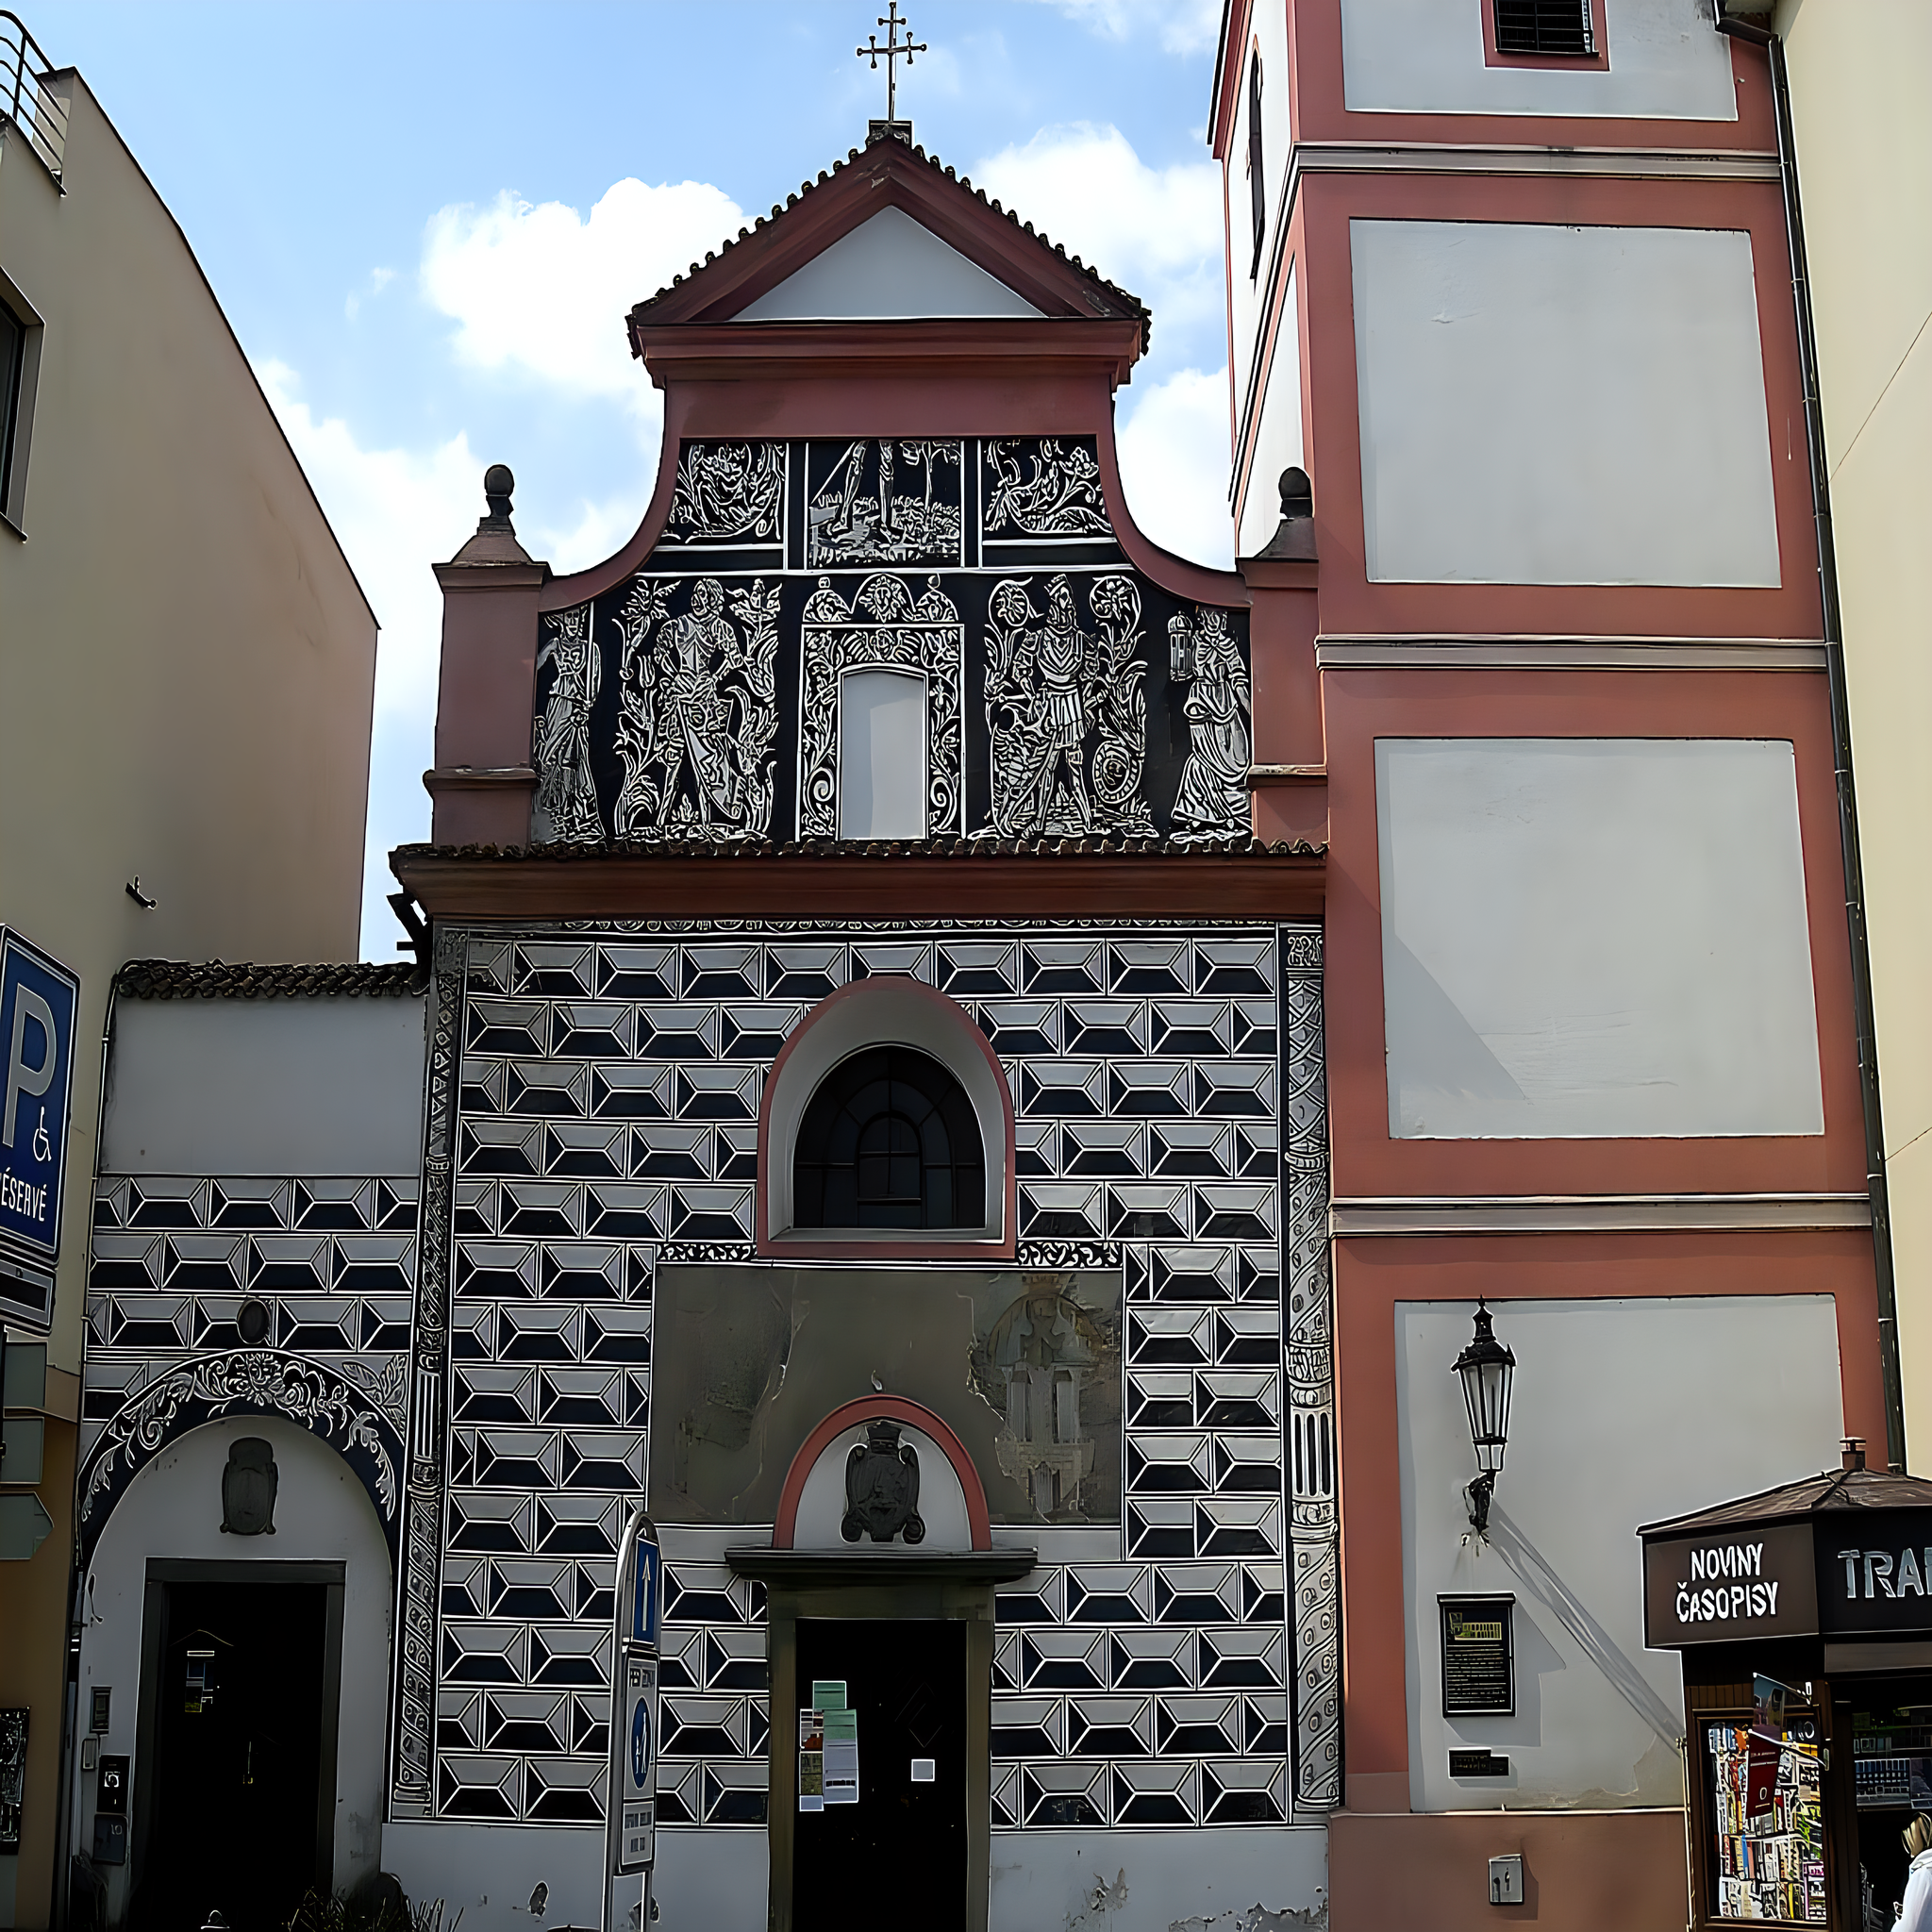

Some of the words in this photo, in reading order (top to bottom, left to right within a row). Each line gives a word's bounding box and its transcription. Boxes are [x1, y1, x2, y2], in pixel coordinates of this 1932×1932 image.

[3, 982, 57, 1147] P
[0, 1166, 47, 1222] ÉSERVÉ
[1690, 1542, 1764, 1581] NOVINY
[1675, 1581, 1778, 1623] ČASOPISY
